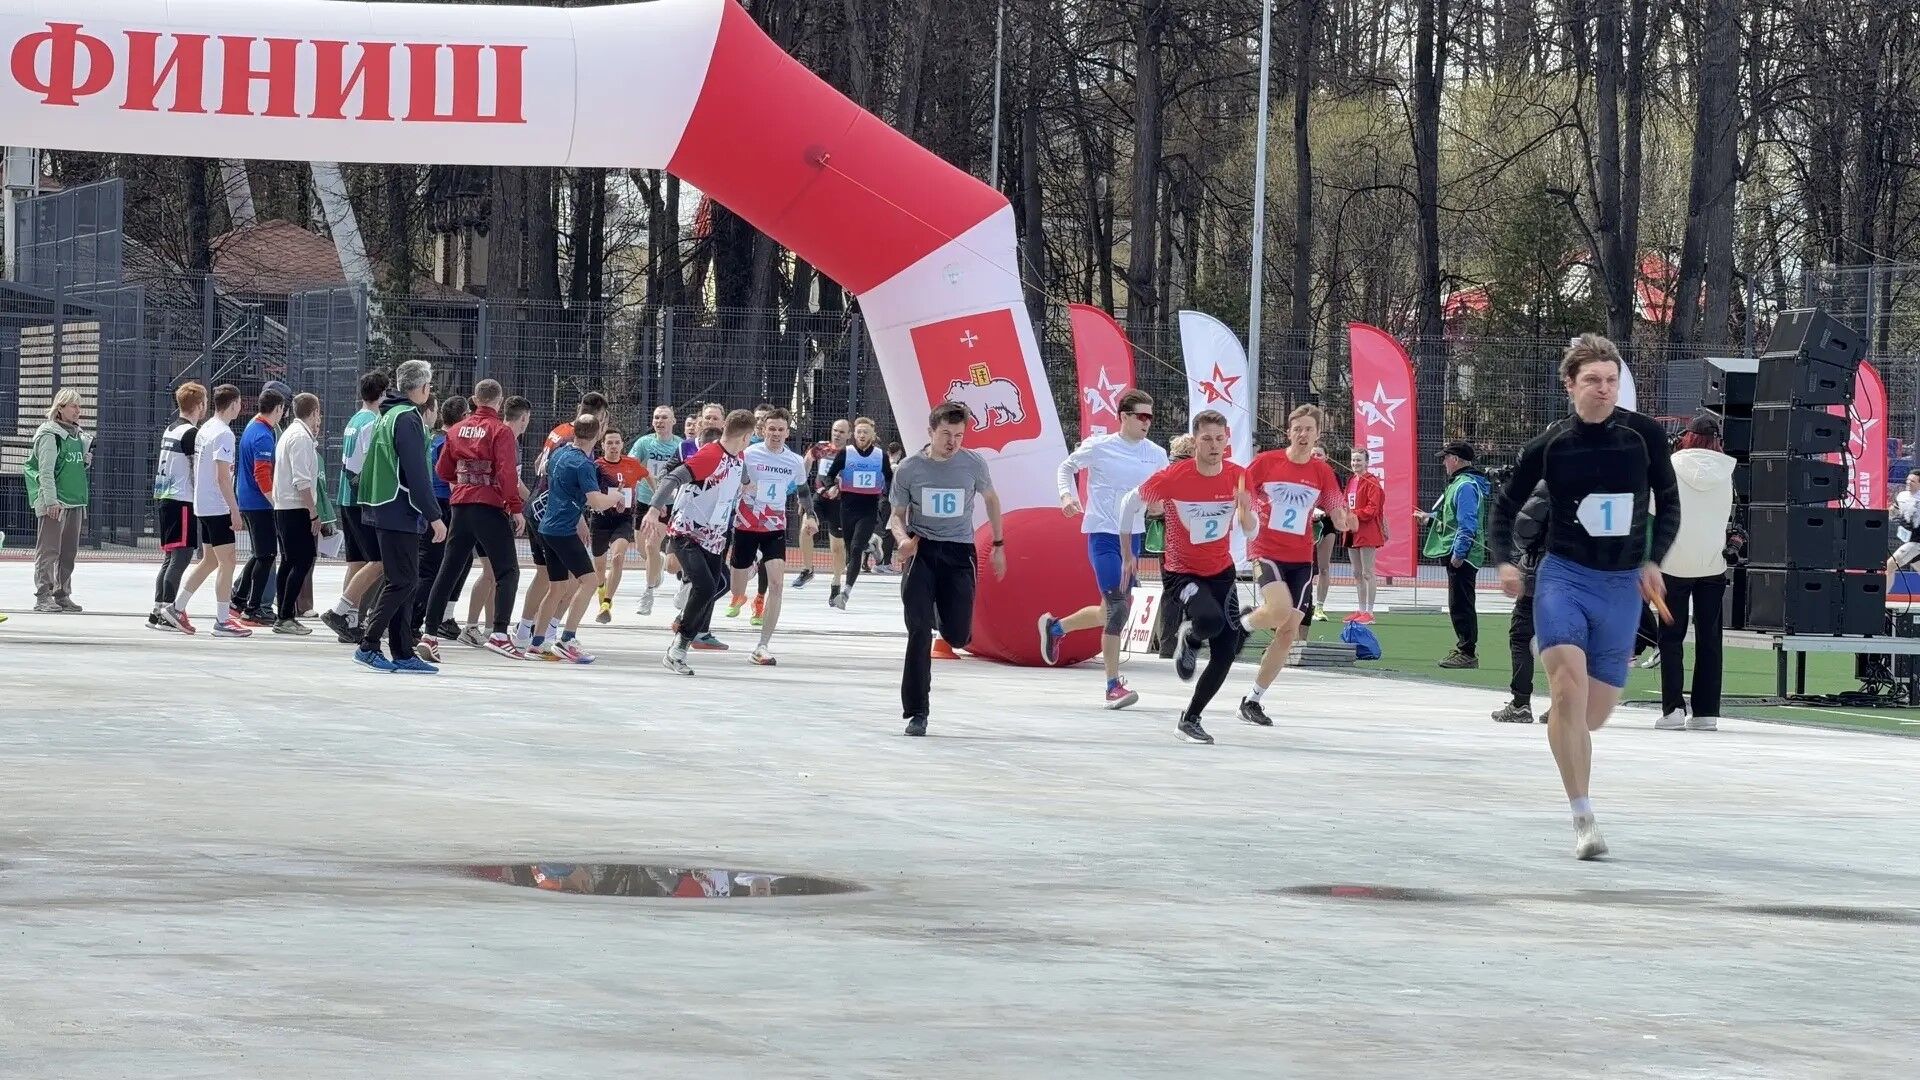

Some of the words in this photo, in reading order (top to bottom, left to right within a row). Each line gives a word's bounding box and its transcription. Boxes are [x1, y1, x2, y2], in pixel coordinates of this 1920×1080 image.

[10, 22, 527, 123] ФИНИШ
[764, 465, 792, 475] ЛУКОЙЛ
[858, 474, 872, 486] 12
[766, 483, 777, 500] 4
[932, 493, 956, 514] 16
[721, 505, 730, 523] 4
[1282, 508, 1297, 529] 2
[1600, 500, 1612, 530] 1
[1205, 520, 1218, 539] 2
[1141, 595, 1154, 625] 3
